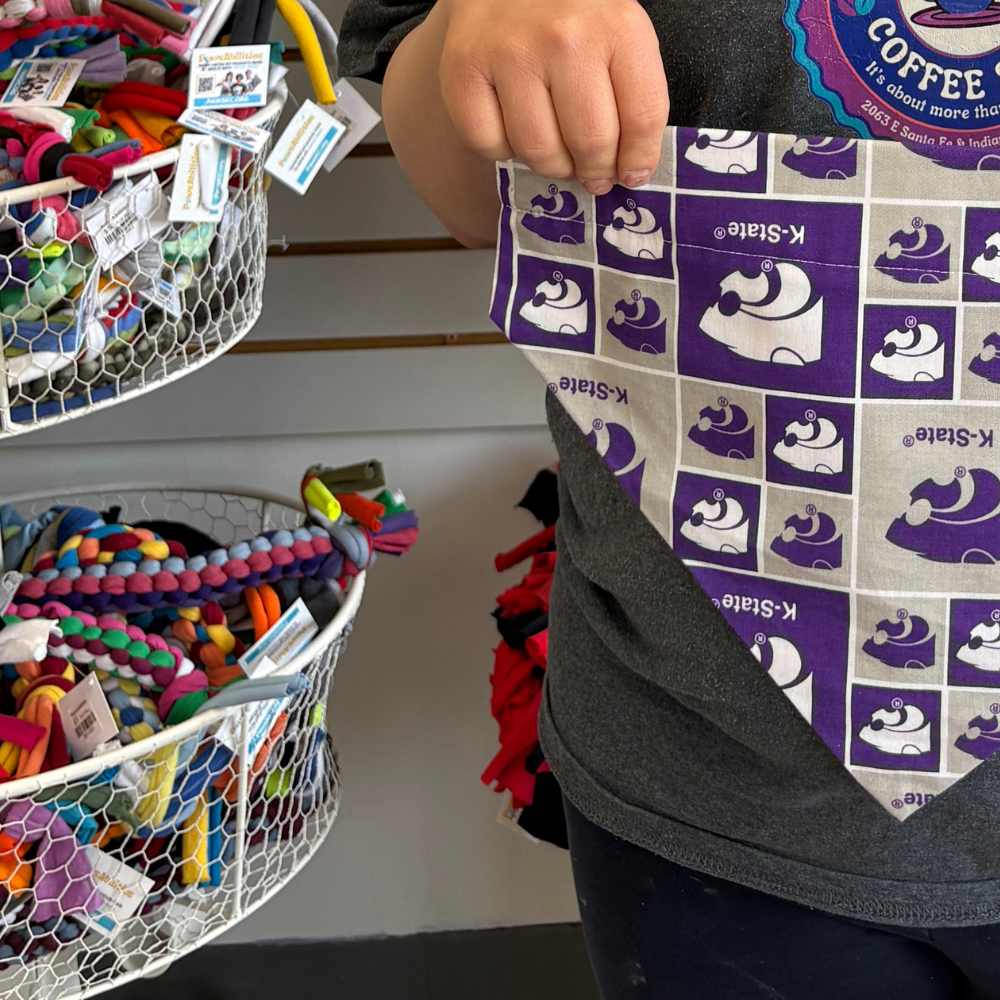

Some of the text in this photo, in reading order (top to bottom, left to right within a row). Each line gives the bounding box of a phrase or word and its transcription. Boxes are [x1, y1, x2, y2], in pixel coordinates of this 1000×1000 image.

[868, 17, 985, 99] COFFEE
[865, 61, 886, 86] It's
[886, 84, 926, 112] about
[930, 105, 970, 119] more
[861, 100, 892, 126] 2063
[890, 120, 900, 132] E
[900, 126, 936, 146] Santa
